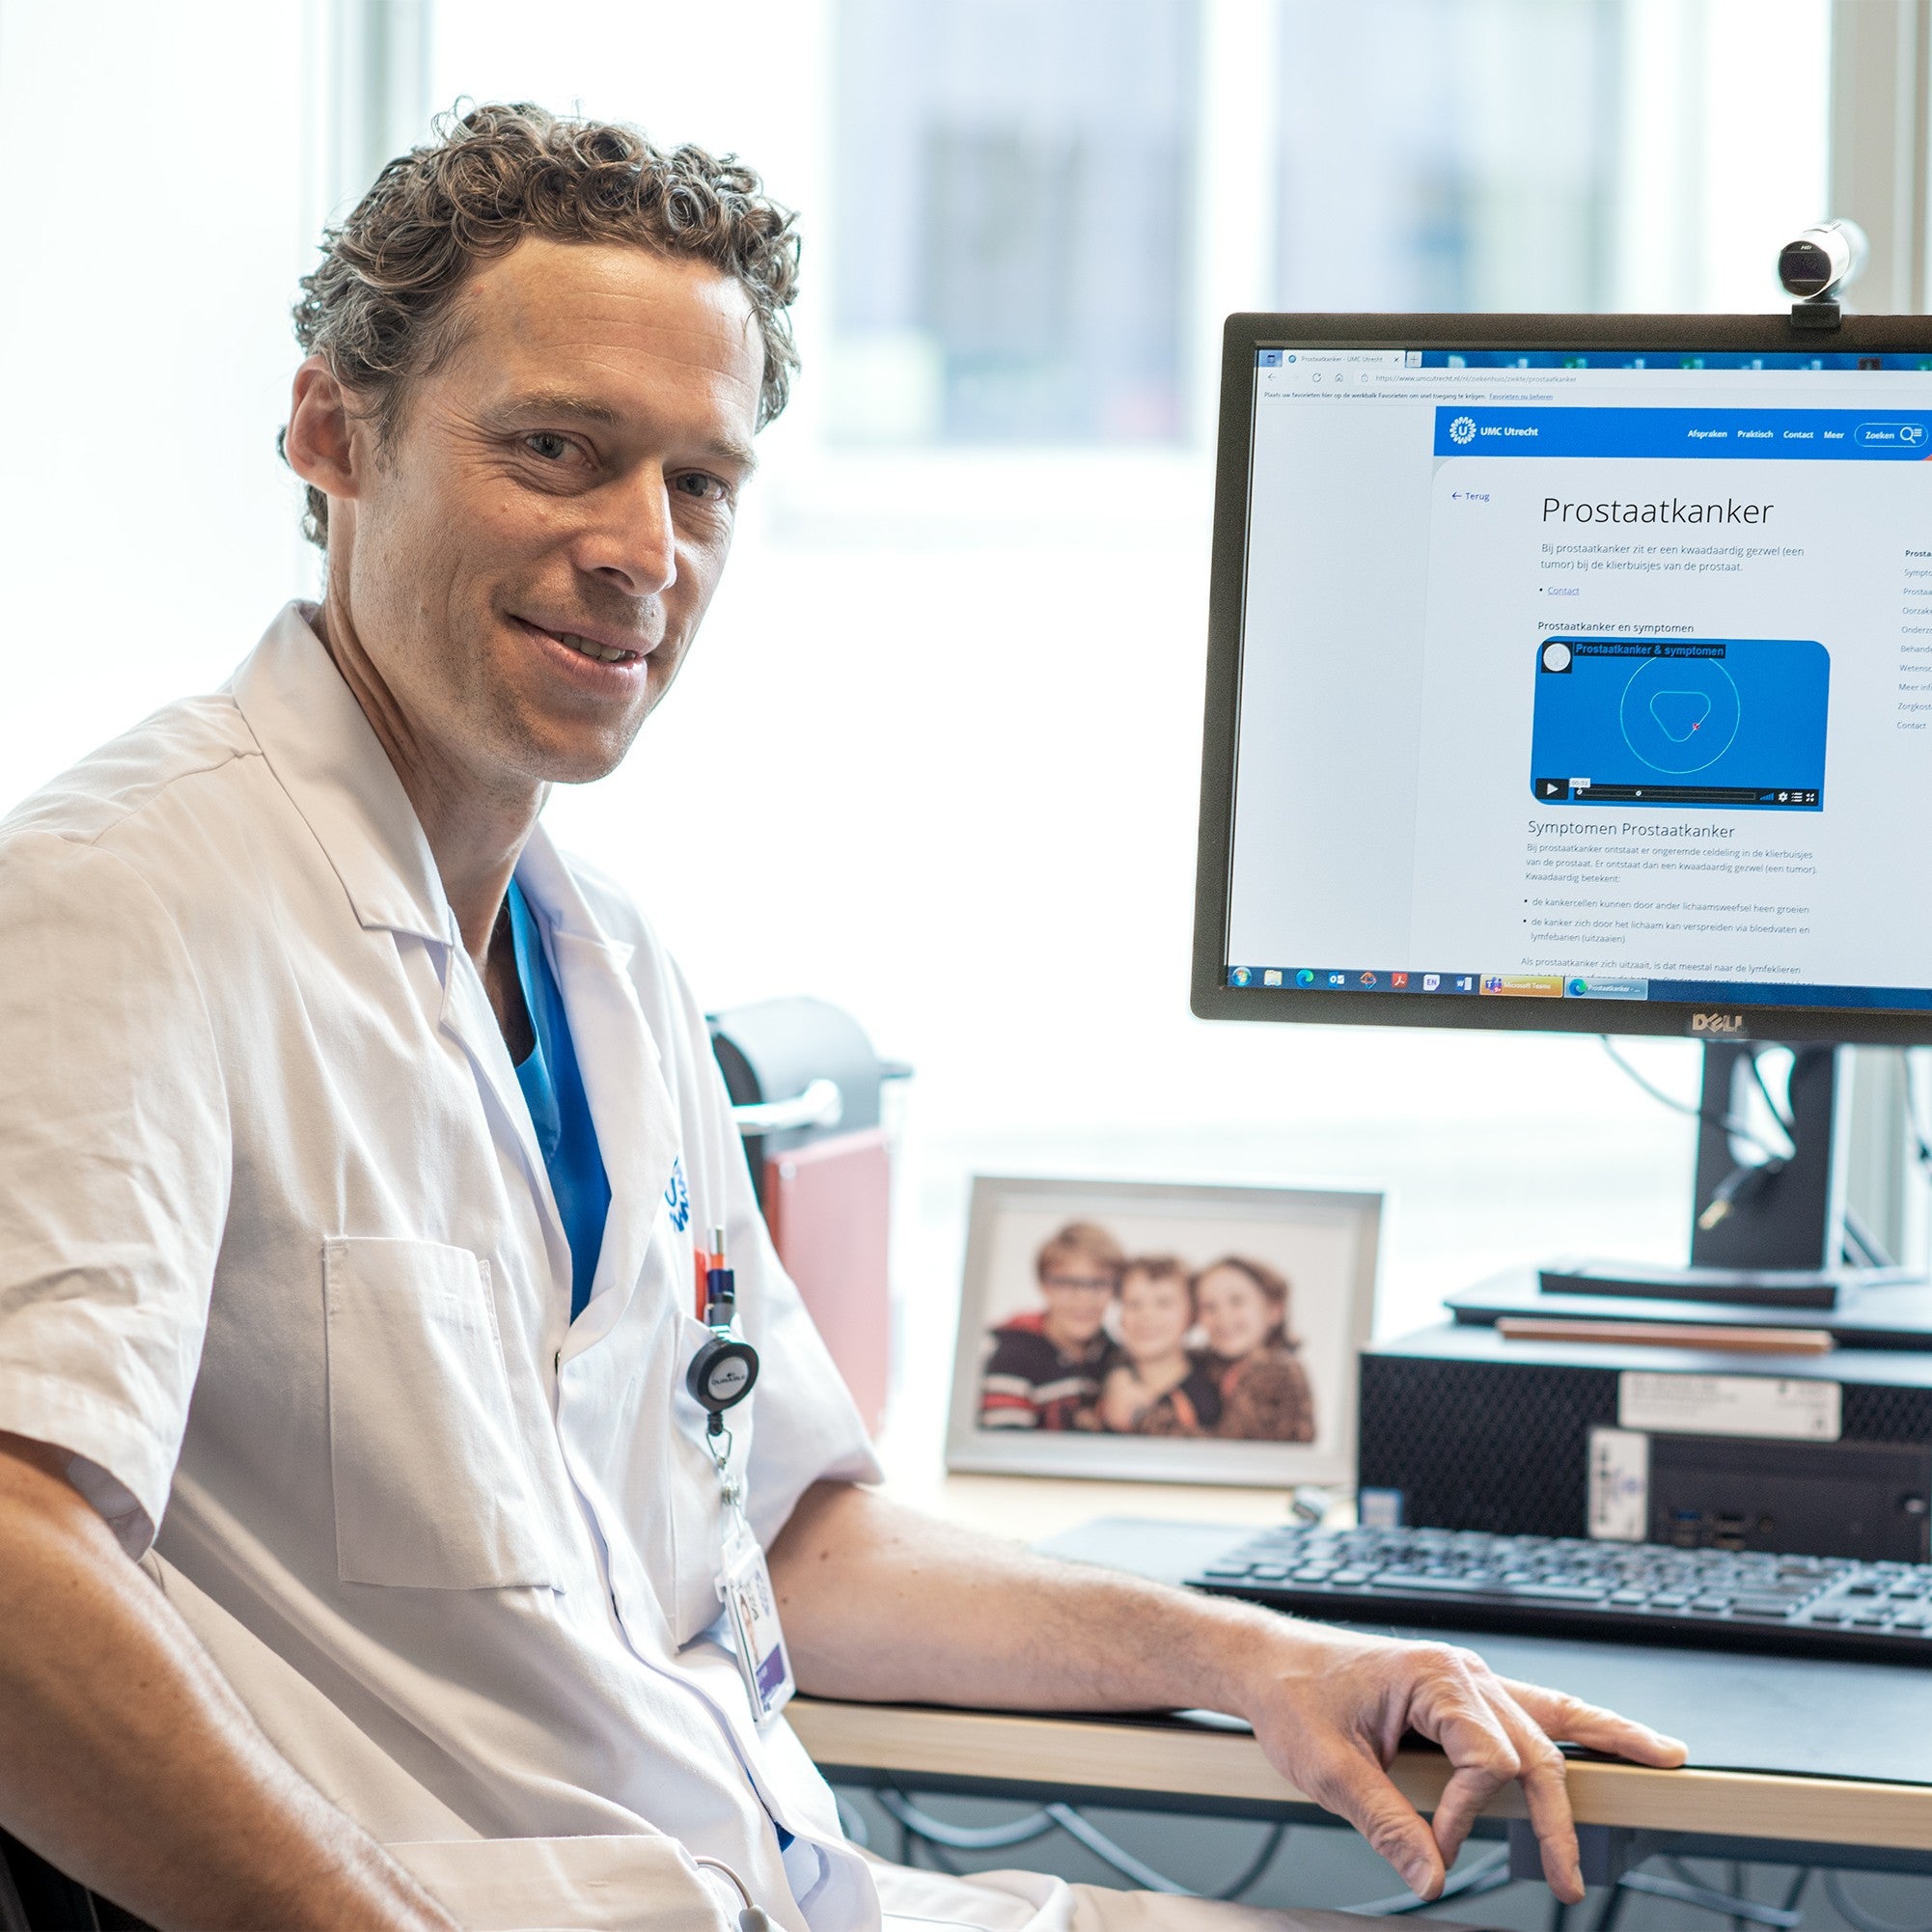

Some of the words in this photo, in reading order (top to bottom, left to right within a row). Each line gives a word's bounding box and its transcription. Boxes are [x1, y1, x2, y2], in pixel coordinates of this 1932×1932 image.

[1480, 427, 1503, 436] UMC
[1504, 427, 1538, 436] Utrecht
[1687, 428, 1727, 439] Afspraken
[1737, 429, 1774, 439] Praktisch
[1783, 430, 1814, 439] Contact
[1824, 430, 1844, 439] Meer
[1465, 492, 1490, 502] Terug
[1542, 497, 1774, 524] Prostaatkanker
[1542, 543, 1555, 556] Bij
[1557, 544, 1629, 556] prostaatkanker
[1633, 544, 1644, 554] zit
[1660, 546, 1678, 555] een
[1681, 545, 1743, 557] kwaadaardig
[1747, 546, 1780, 558] gezwel
[1782, 546, 1804, 558] (een
[1540, 560, 1574, 570] tumor)
[1577, 560, 1588, 571] bij
[1591, 560, 1603, 570] de
[1606, 561, 1661, 572] klierbuisjes
[1684, 562, 1697, 571] de
[1698, 562, 1743, 573] prostaat.
[1547, 586, 1580, 595] Contact
[1538, 621, 1615, 632] Prostaatkanker
[1618, 623, 1631, 632] en
[1633, 623, 1694, 634] symptomen
[1575, 645, 1651, 655] Prostaatkanker
[1654, 646, 1662, 654] &
[1665, 647, 1724, 658] symptomen
[1528, 820, 1616, 837] Symptomen
[1622, 822, 1735, 838] Prostaatkanker
[1527, 843, 1537, 853] Bij
[1539, 843, 1602, 853] prostaatkanker
[1605, 845, 1639, 854] ontstaat
[1652, 847, 1700, 857] ongeremde
[1702, 847, 1740, 859] celdeling
[1765, 849, 1813, 860] klierbuisjes
[1679, 863, 1732, 873] kwaadaardig
[1735, 865, 1763, 873] gezwel
[1765, 865, 1783, 874] (een
[1526, 872, 1580, 884] Kwaadaardig
[1582, 874, 1620, 883] betekent:
[1546, 898, 1597, 907] kankercellen
[1633, 900, 1653, 909] door
[1683, 902, 1752, 912] lichaamsweefsel
[1753, 904, 1774, 913] heen
[1777, 906, 1809, 915] groeien
[1631, 921, 1664, 929] lichaam
[1683, 923, 1733, 932] verspreiden
[1750, 925, 1797, 933] bloedvaten
[1531, 933, 1580, 943] lymfebanen
[1582, 934, 1625, 944] (uitzaaien)
[1535, 958, 1599, 968] prostaatkanker
[1601, 959, 1617, 968] zich
[1619, 961, 1652, 970] uitzaait,
[1653, 961, 1660, 970] is
[1662, 962, 1676, 971] dat
[1735, 964, 1747, 973] de
[1749, 965, 1801, 975] lymfeklieren
[1693, 1013, 1743, 1033] DELL
